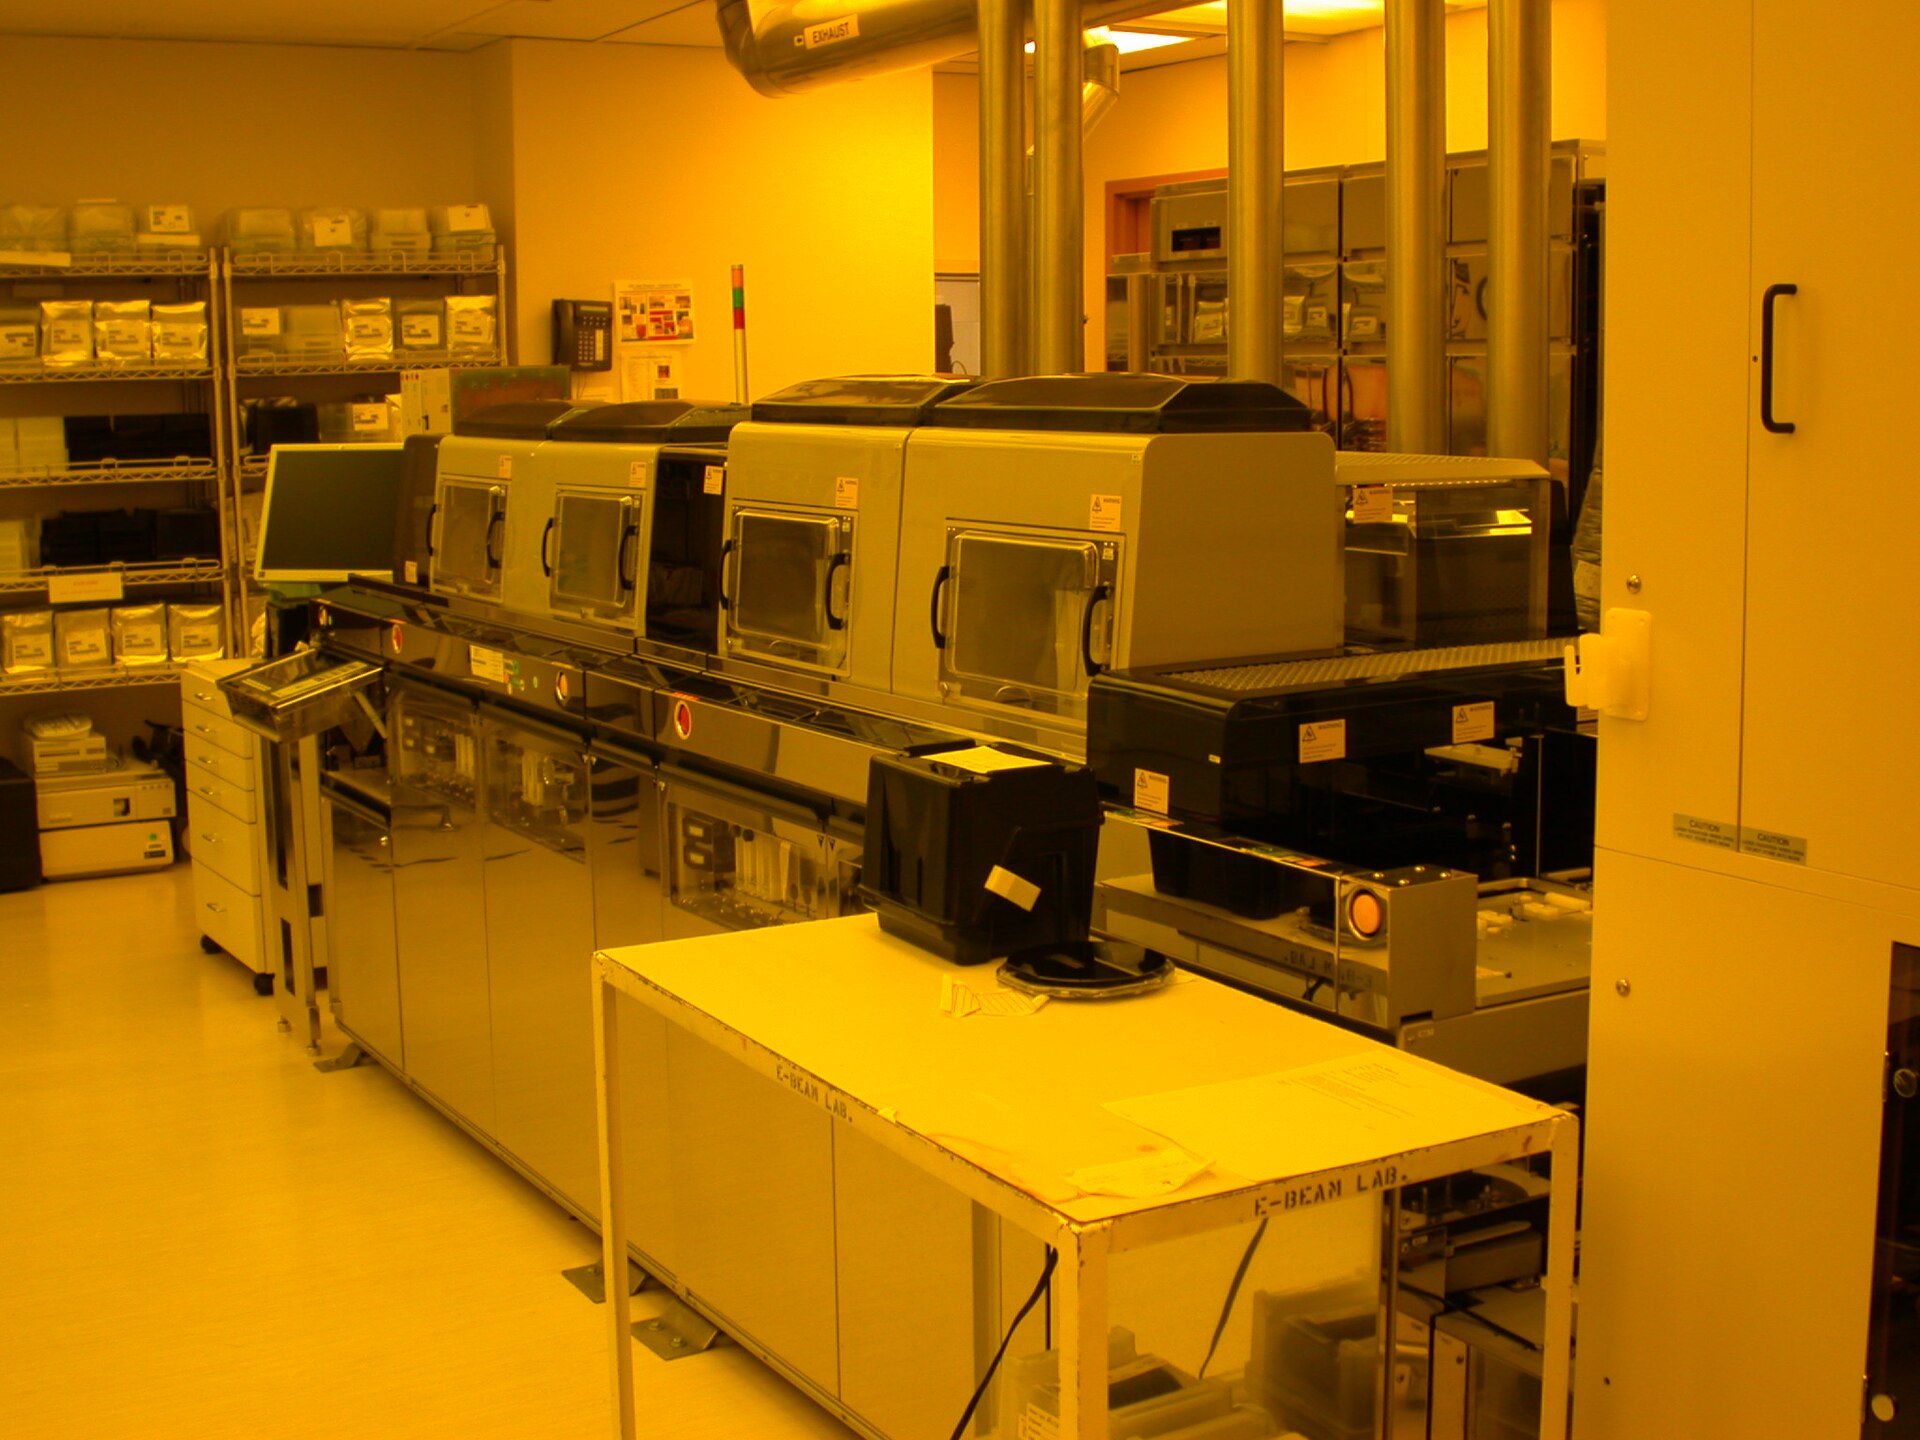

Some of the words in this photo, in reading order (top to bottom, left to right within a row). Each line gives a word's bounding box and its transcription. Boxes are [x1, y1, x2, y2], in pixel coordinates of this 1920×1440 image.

[812, 22, 849, 44] EXHAUST
[777, 1064, 819, 1102] E-BEAM
[825, 1092, 853, 1123] LAB.
[1255, 1179, 1342, 1216] E-BEAM
[1356, 1166, 1407, 1192] LAB.
